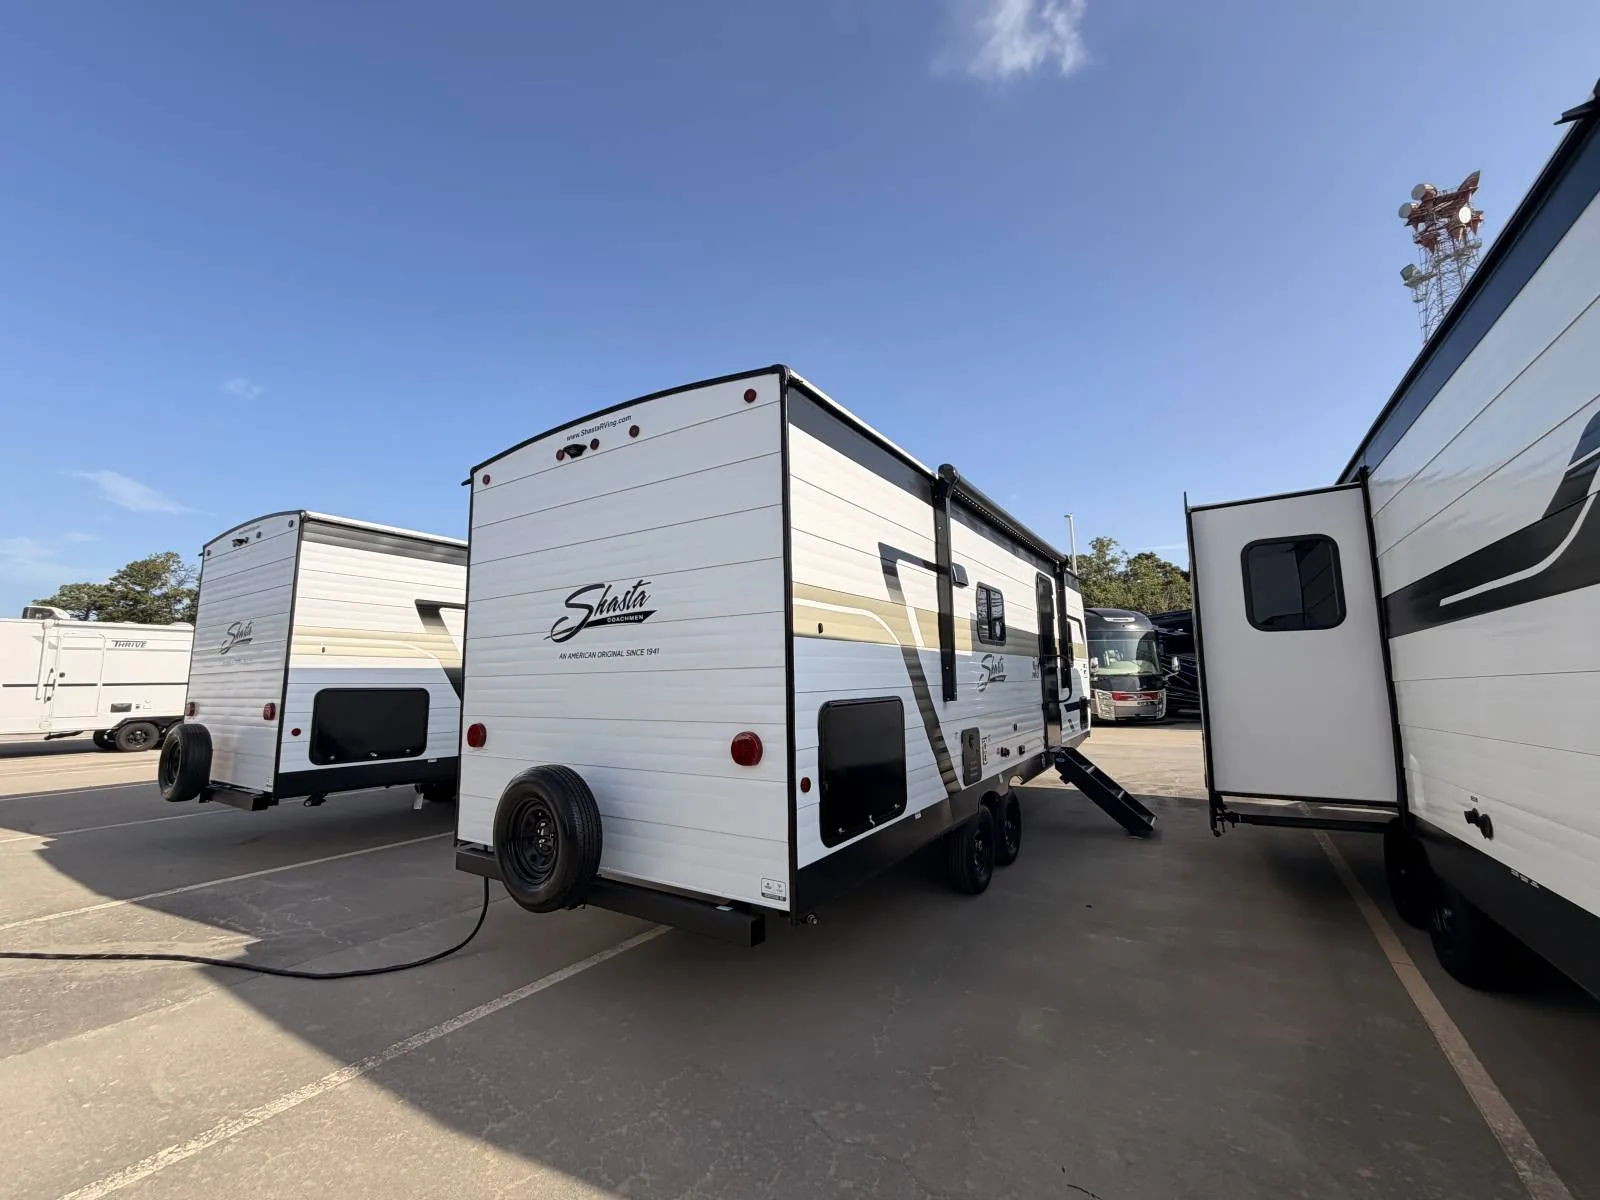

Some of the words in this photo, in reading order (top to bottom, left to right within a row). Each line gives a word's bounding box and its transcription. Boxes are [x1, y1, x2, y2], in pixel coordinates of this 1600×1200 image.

[566, 414, 632, 441] www.ShastaRVing.com
[550, 579, 652, 643] Shasta
[606, 614, 644, 623] COACHMEN
[111, 640, 147, 648] THRIVE
[559, 652, 567, 660] AN
[567, 650, 597, 659] AMERICAN
[597, 649, 625, 658] ORIGINAL
[626, 648, 645, 657] SINCE
[646, 647, 660, 655] 1941
